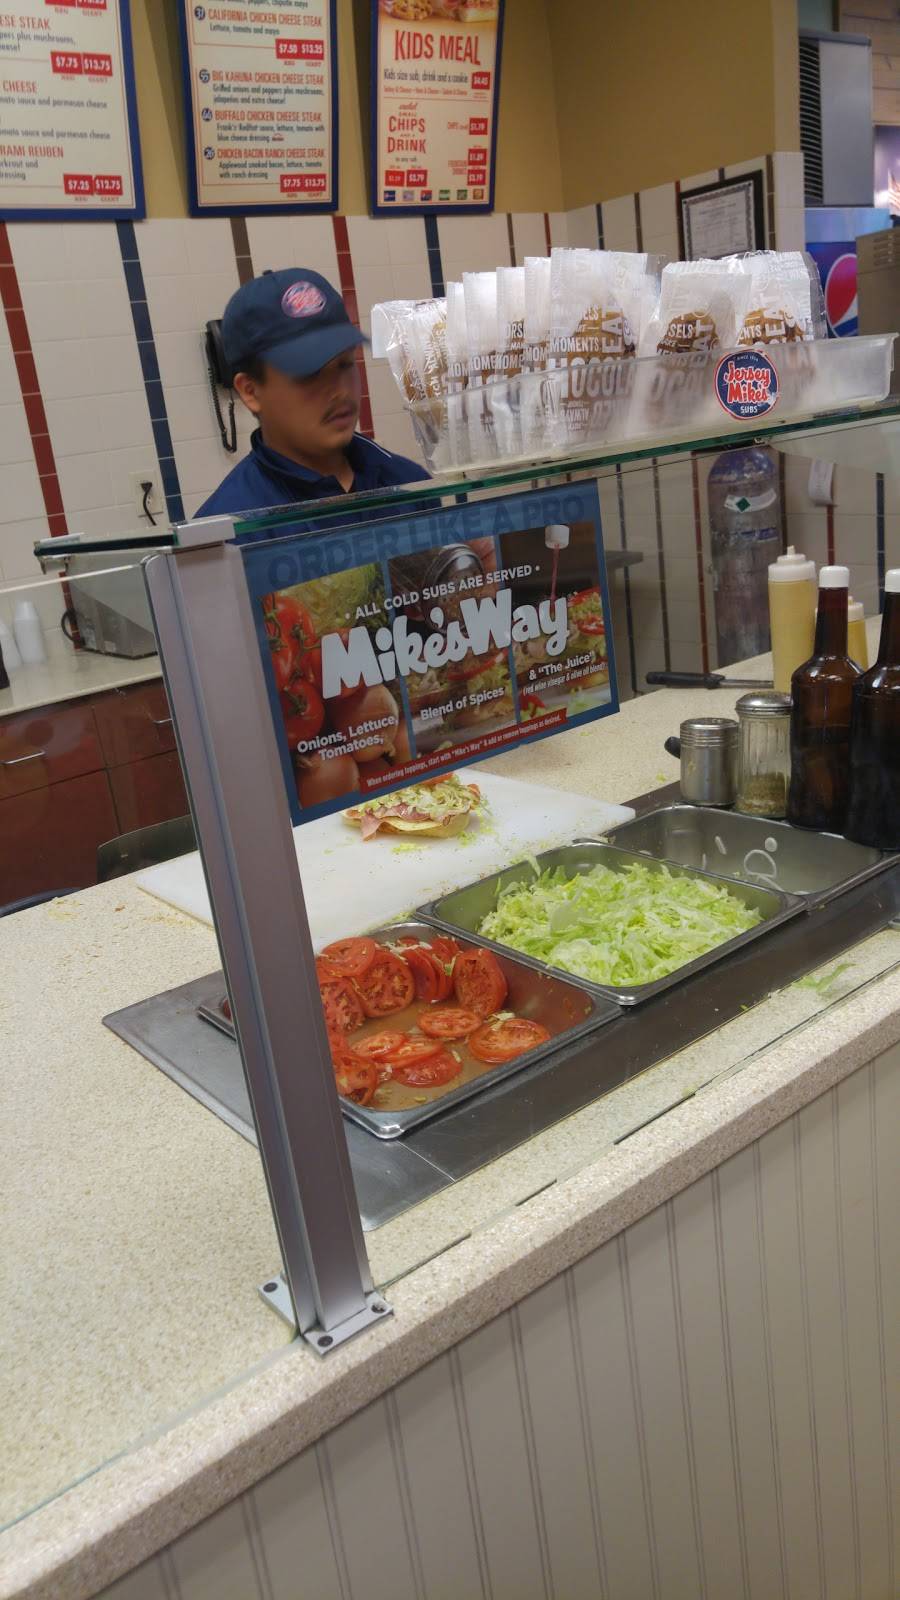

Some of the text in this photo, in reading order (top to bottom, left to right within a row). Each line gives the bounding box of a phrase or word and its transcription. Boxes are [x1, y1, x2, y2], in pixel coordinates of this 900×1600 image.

[19, 16, 50, 30] STEAK
[208, 9, 247, 22] CALIFORNIA
[250, 12, 277, 24] CHICKEN
[278, 13, 301, 25] CHEESE
[303, 16, 322, 26] STEAK
[394, 30, 480, 66] KIDS MEAL
[56, 56, 78, 68] $7.75
[3, 80, 38, 93] CHEESE
[212, 71, 324, 85] BIG KAHUNA CHICKEN CHEESE STEAK
[215, 110, 322, 122] BUFFALO CHICKEN CHEESE STEAK
[389, 116, 425, 133] CHIPS
[28, 145, 64, 158] REUBEN
[217, 149, 242, 158] CHICKEN
[243, 148, 264, 158] BACON
[388, 137, 426, 154] DRINK
[96, 180, 120, 190] $12.75
[550, 336, 599, 352] MOMENTS
[724, 360, 771, 388] Jersey
[727, 382, 770, 404] Mike's
[741, 406, 758, 414] SUBS
[268, 493, 585, 588] ORDER LIKE A PRO
[356, 565, 532, 620] ALL COLD SUBS ARE SERVED
[320, 588, 570, 700] Mike's Way
[529, 670, 536, 680] &
[421, 687, 505, 721] Blend of Spices
[297, 715, 399, 753] Onions, Lettuce,
[319, 734, 384, 761] Tomatoes,
[366, 777, 382, 787] When
[383, 769, 404, 783] ordering
[404, 762, 427, 776] toppings,
[428, 757, 440, 766] start
[441, 754, 451, 762] with
[488, 736, 497, 745] add
[503, 730, 519, 740] remove
[520, 722, 538, 736] toppings
